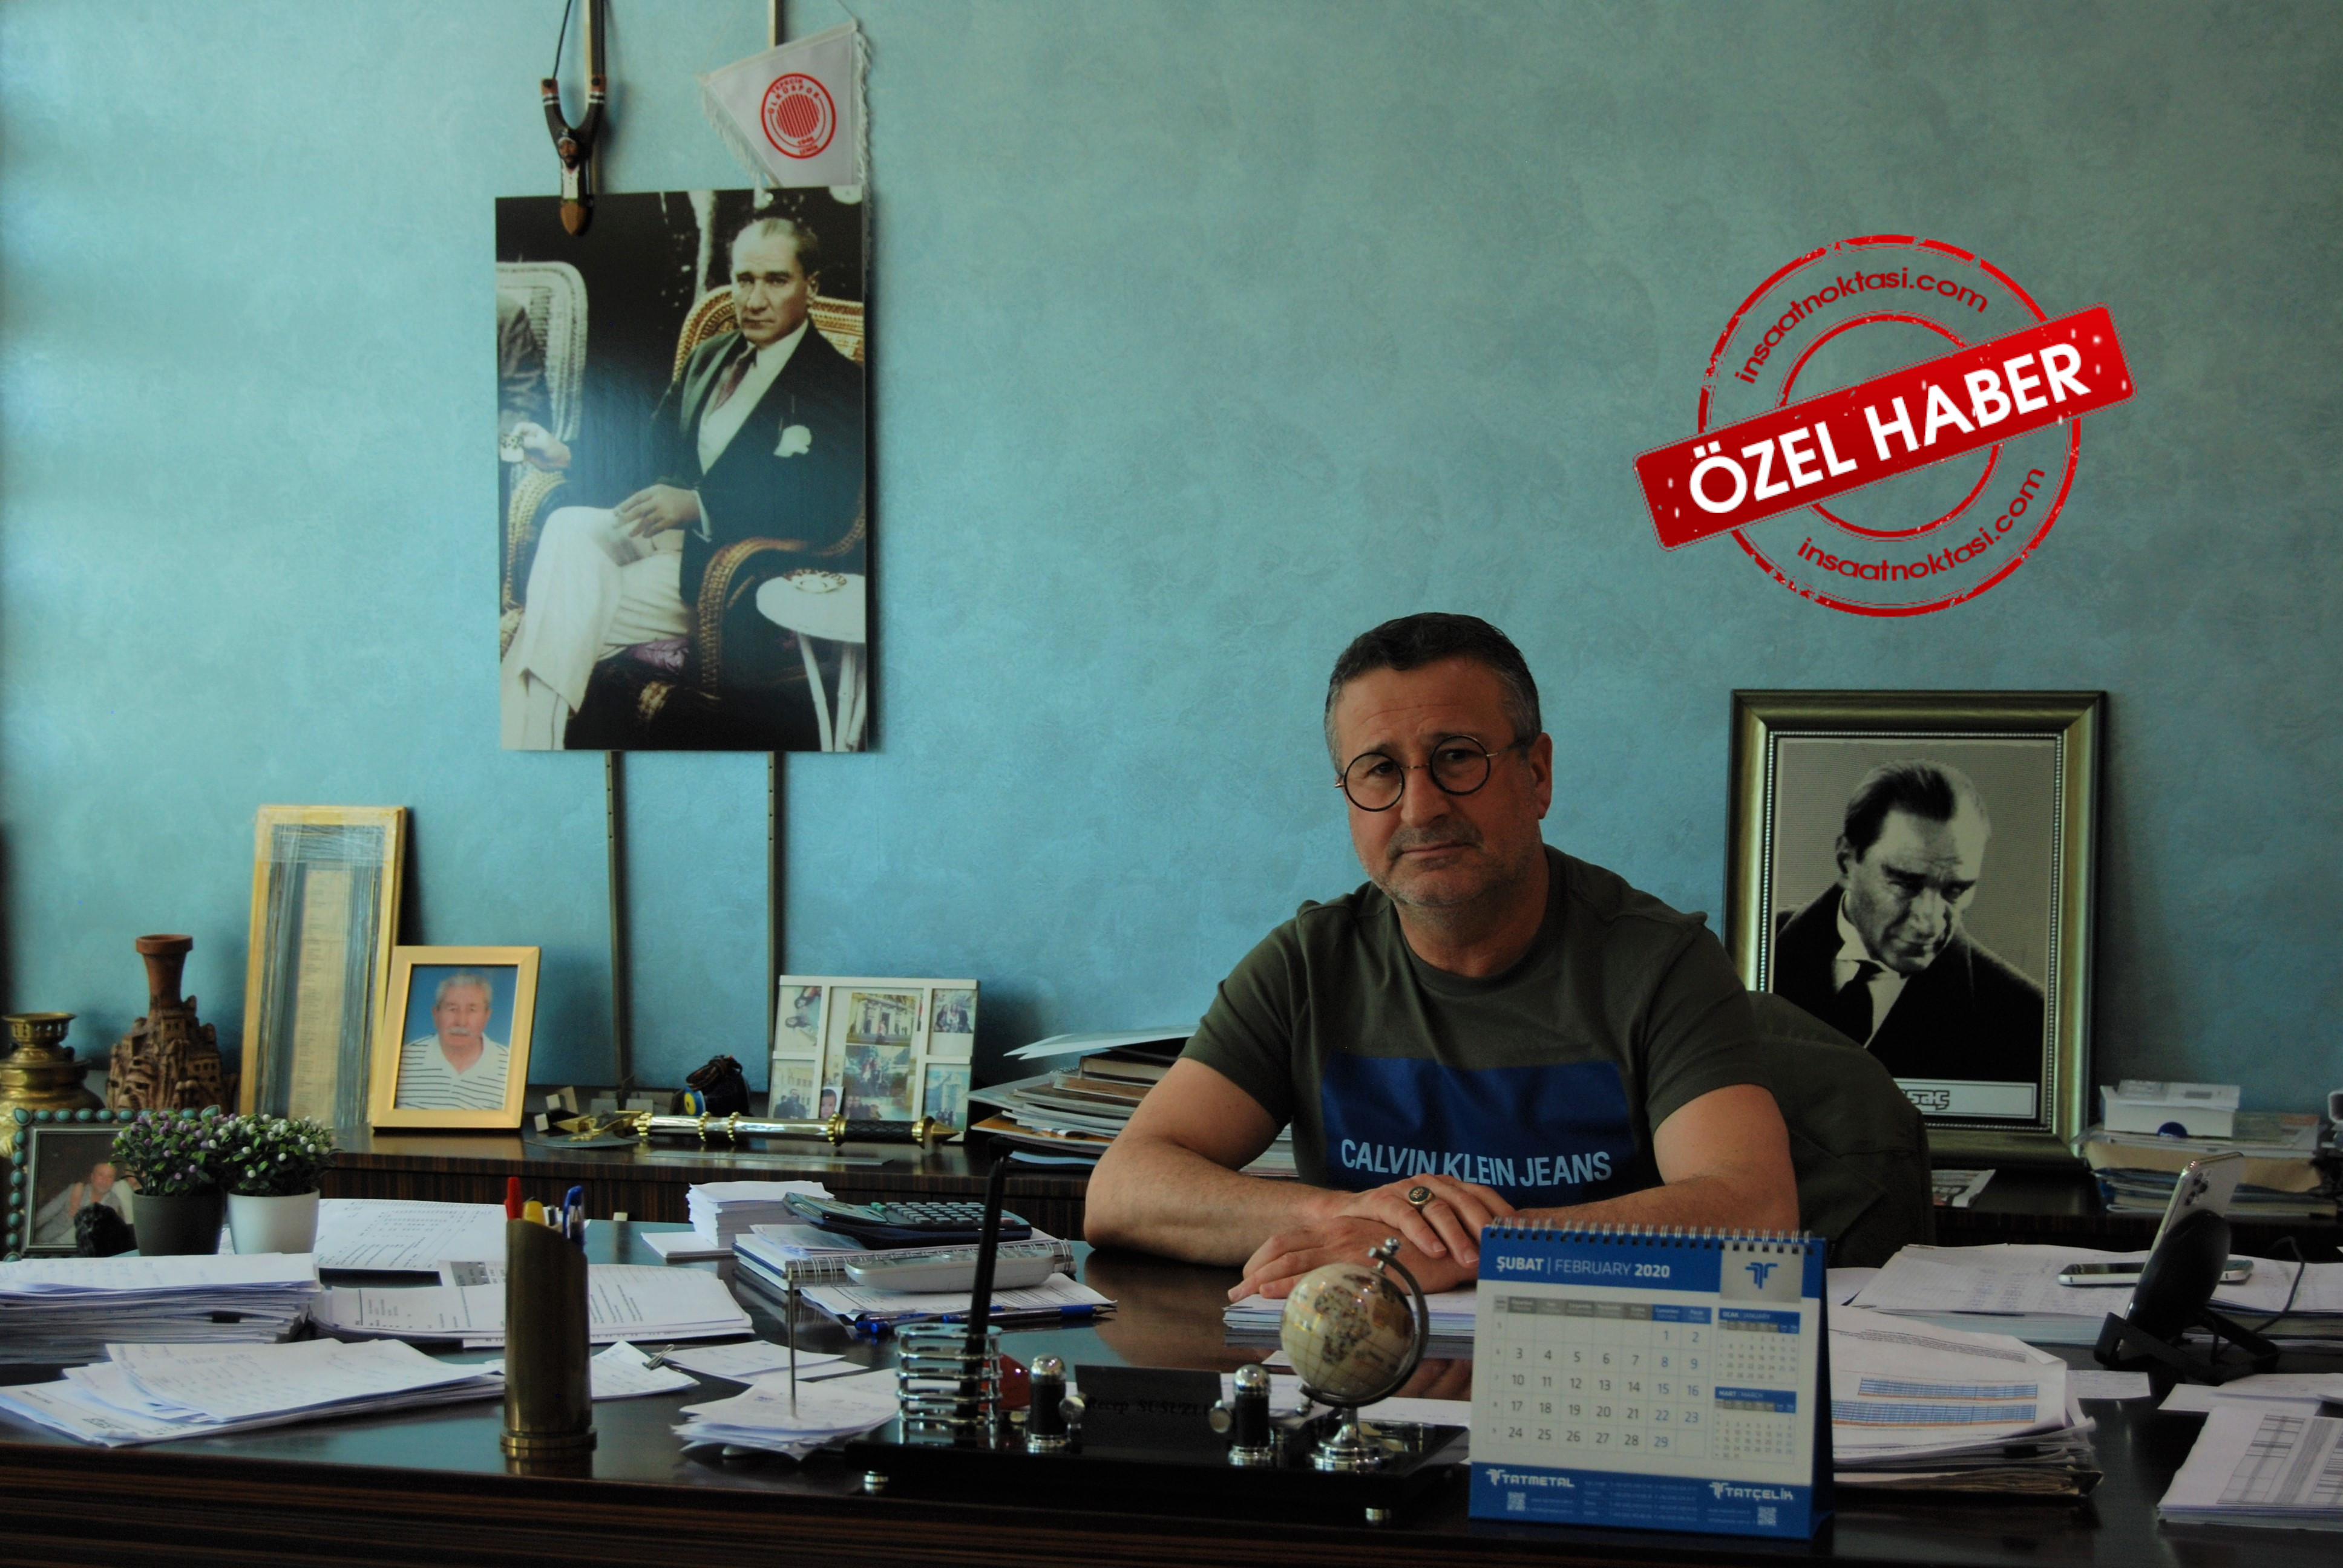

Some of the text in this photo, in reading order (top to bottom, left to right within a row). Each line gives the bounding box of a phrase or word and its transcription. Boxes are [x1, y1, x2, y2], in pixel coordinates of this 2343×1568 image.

[1341, 1138, 1613, 1187] CALVIN KLEIN JEANS
[1496, 1256, 1671, 1278] ŞUBAT FEBRUARY 2020
[1664, 1330, 1668, 1341] 1
[1693, 1331, 1699, 1343] 2
[1516, 1348, 1523, 1359] 3
[1544, 1350, 1552, 1361] 4
[1574, 1351, 1581, 1363] 5
[1603, 1353, 1610, 1365] 6
[1633, 1355, 1640, 1365] 7
[1661, 1356, 1668, 1368] 8
[1691, 1358, 1698, 1370] 9
[1512, 1374, 1525, 1386] 10
[1542, 1376, 1552, 1387] 11
[1570, 1378, 1582, 1390] 12
[1599, 1379, 1611, 1391] 13
[1628, 1382, 1640, 1393] 14
[1658, 1383, 1670, 1394] 15
[1687, 1385, 1699, 1396] 16
[1512, 1400, 1523, 1411] 17
[1539, 1402, 1552, 1414] 18
[1568, 1404, 1581, 1416] 19
[1596, 1406, 1611, 1417] 20
[1627, 1408, 1639, 1419] 21
[1655, 1410, 1669, 1421] 22
[1685, 1411, 1699, 1423] 23
[1509, 1426, 1523, 1438] 24
[1538, 1428, 1552, 1440] 25
[1567, 1430, 1581, 1442] 26
[1595, 1432, 1610, 1444] 27
[1624, 1434, 1639, 1446] 28
[1654, 1436, 1669, 1448] 29
[1502, 1474, 1575, 1488] TATMETAL
[1725, 1488, 1794, 1501] TATÇELİK
